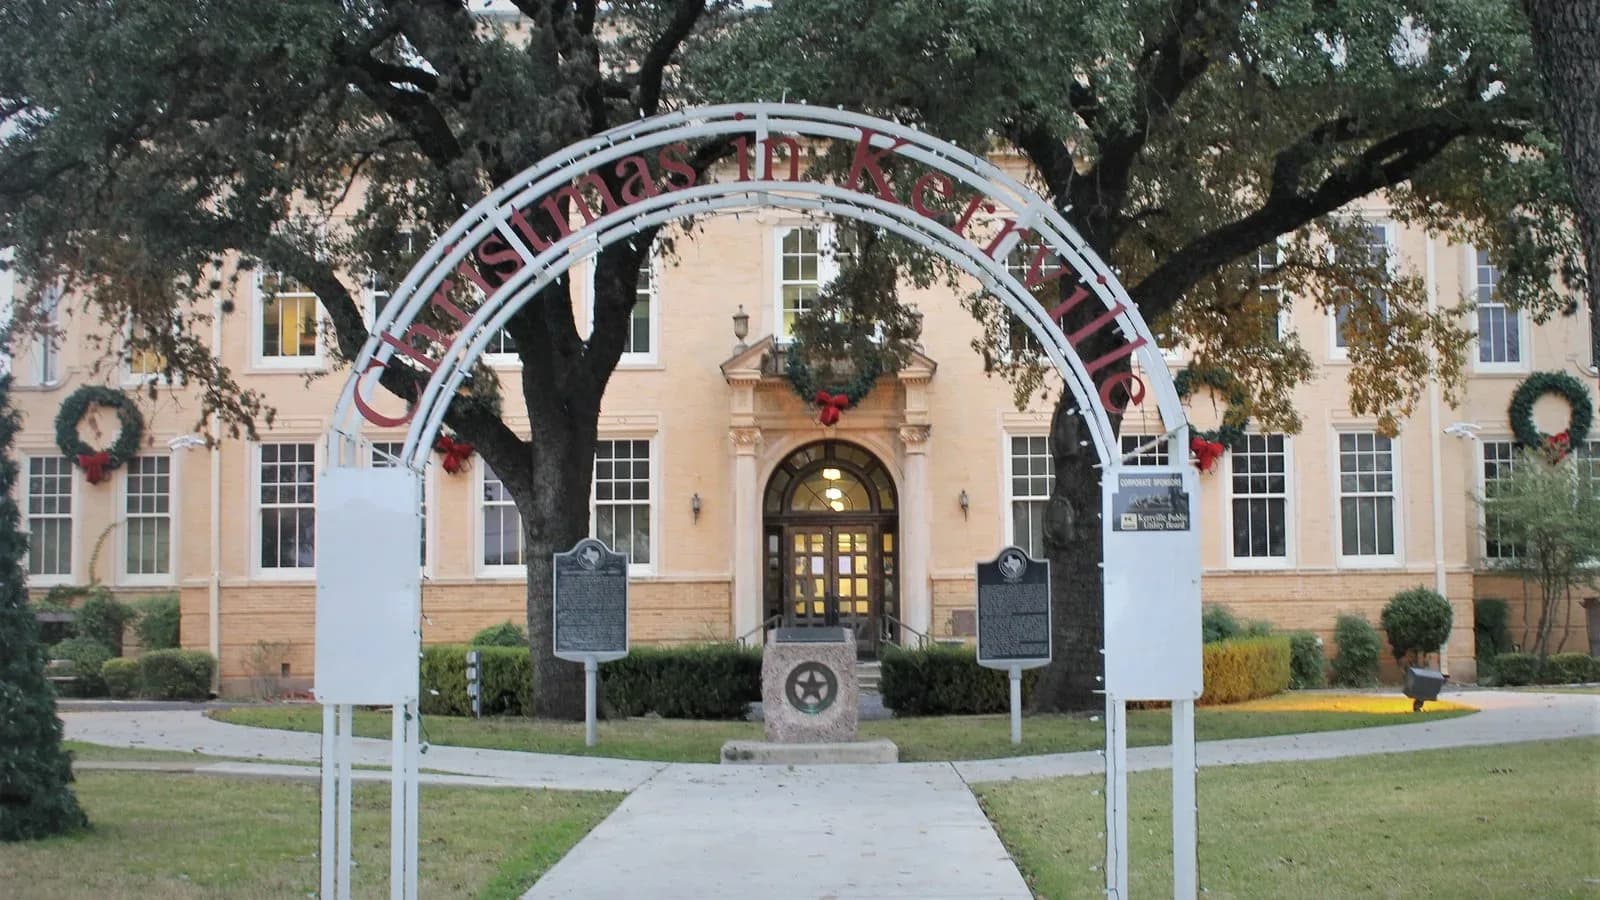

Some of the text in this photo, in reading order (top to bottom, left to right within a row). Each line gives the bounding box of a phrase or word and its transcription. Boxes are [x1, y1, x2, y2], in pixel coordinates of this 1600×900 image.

[354, 111, 1147, 427] Christmas in Kerrville
[1120, 478, 1181, 488] CORPORATE SPONSORS
[1138, 513, 1188, 522] Kerrville Public
[1144, 520, 1164, 529] Utility
[1166, 520, 1185, 529] Board
